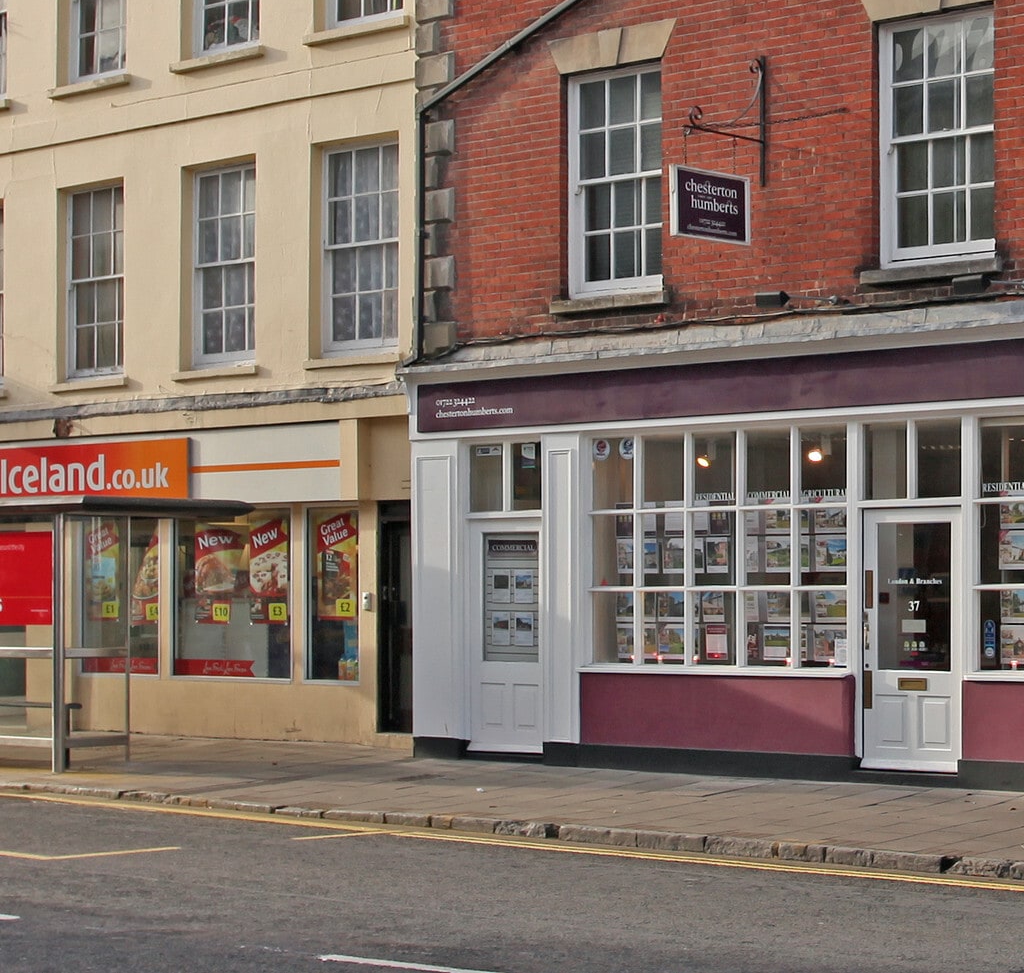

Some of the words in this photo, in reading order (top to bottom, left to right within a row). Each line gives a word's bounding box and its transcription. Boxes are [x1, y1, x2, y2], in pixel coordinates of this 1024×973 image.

[685, 178, 738, 199] chesterton
[691, 194, 739, 215] humberts
[435, 407, 514, 418] chestertonhumberts.com
[1, 454, 169, 494] Iceland.co.uk
[696, 492, 736, 501] RESIDENTIAL
[747, 490, 791, 499] COMMERCIAL
[800, 488, 846, 498] AGRICULTURA
[320, 517, 345, 536] Great
[197, 534, 234, 550] New
[252, 528, 278, 549] New
[322, 528, 349, 546] Value
[915, 577, 943, 585] Branches
[214, 606, 228, 617] £10
[272, 606, 283, 617] £3
[340, 602, 351, 613] £2
[907, 600, 920, 612] 37
